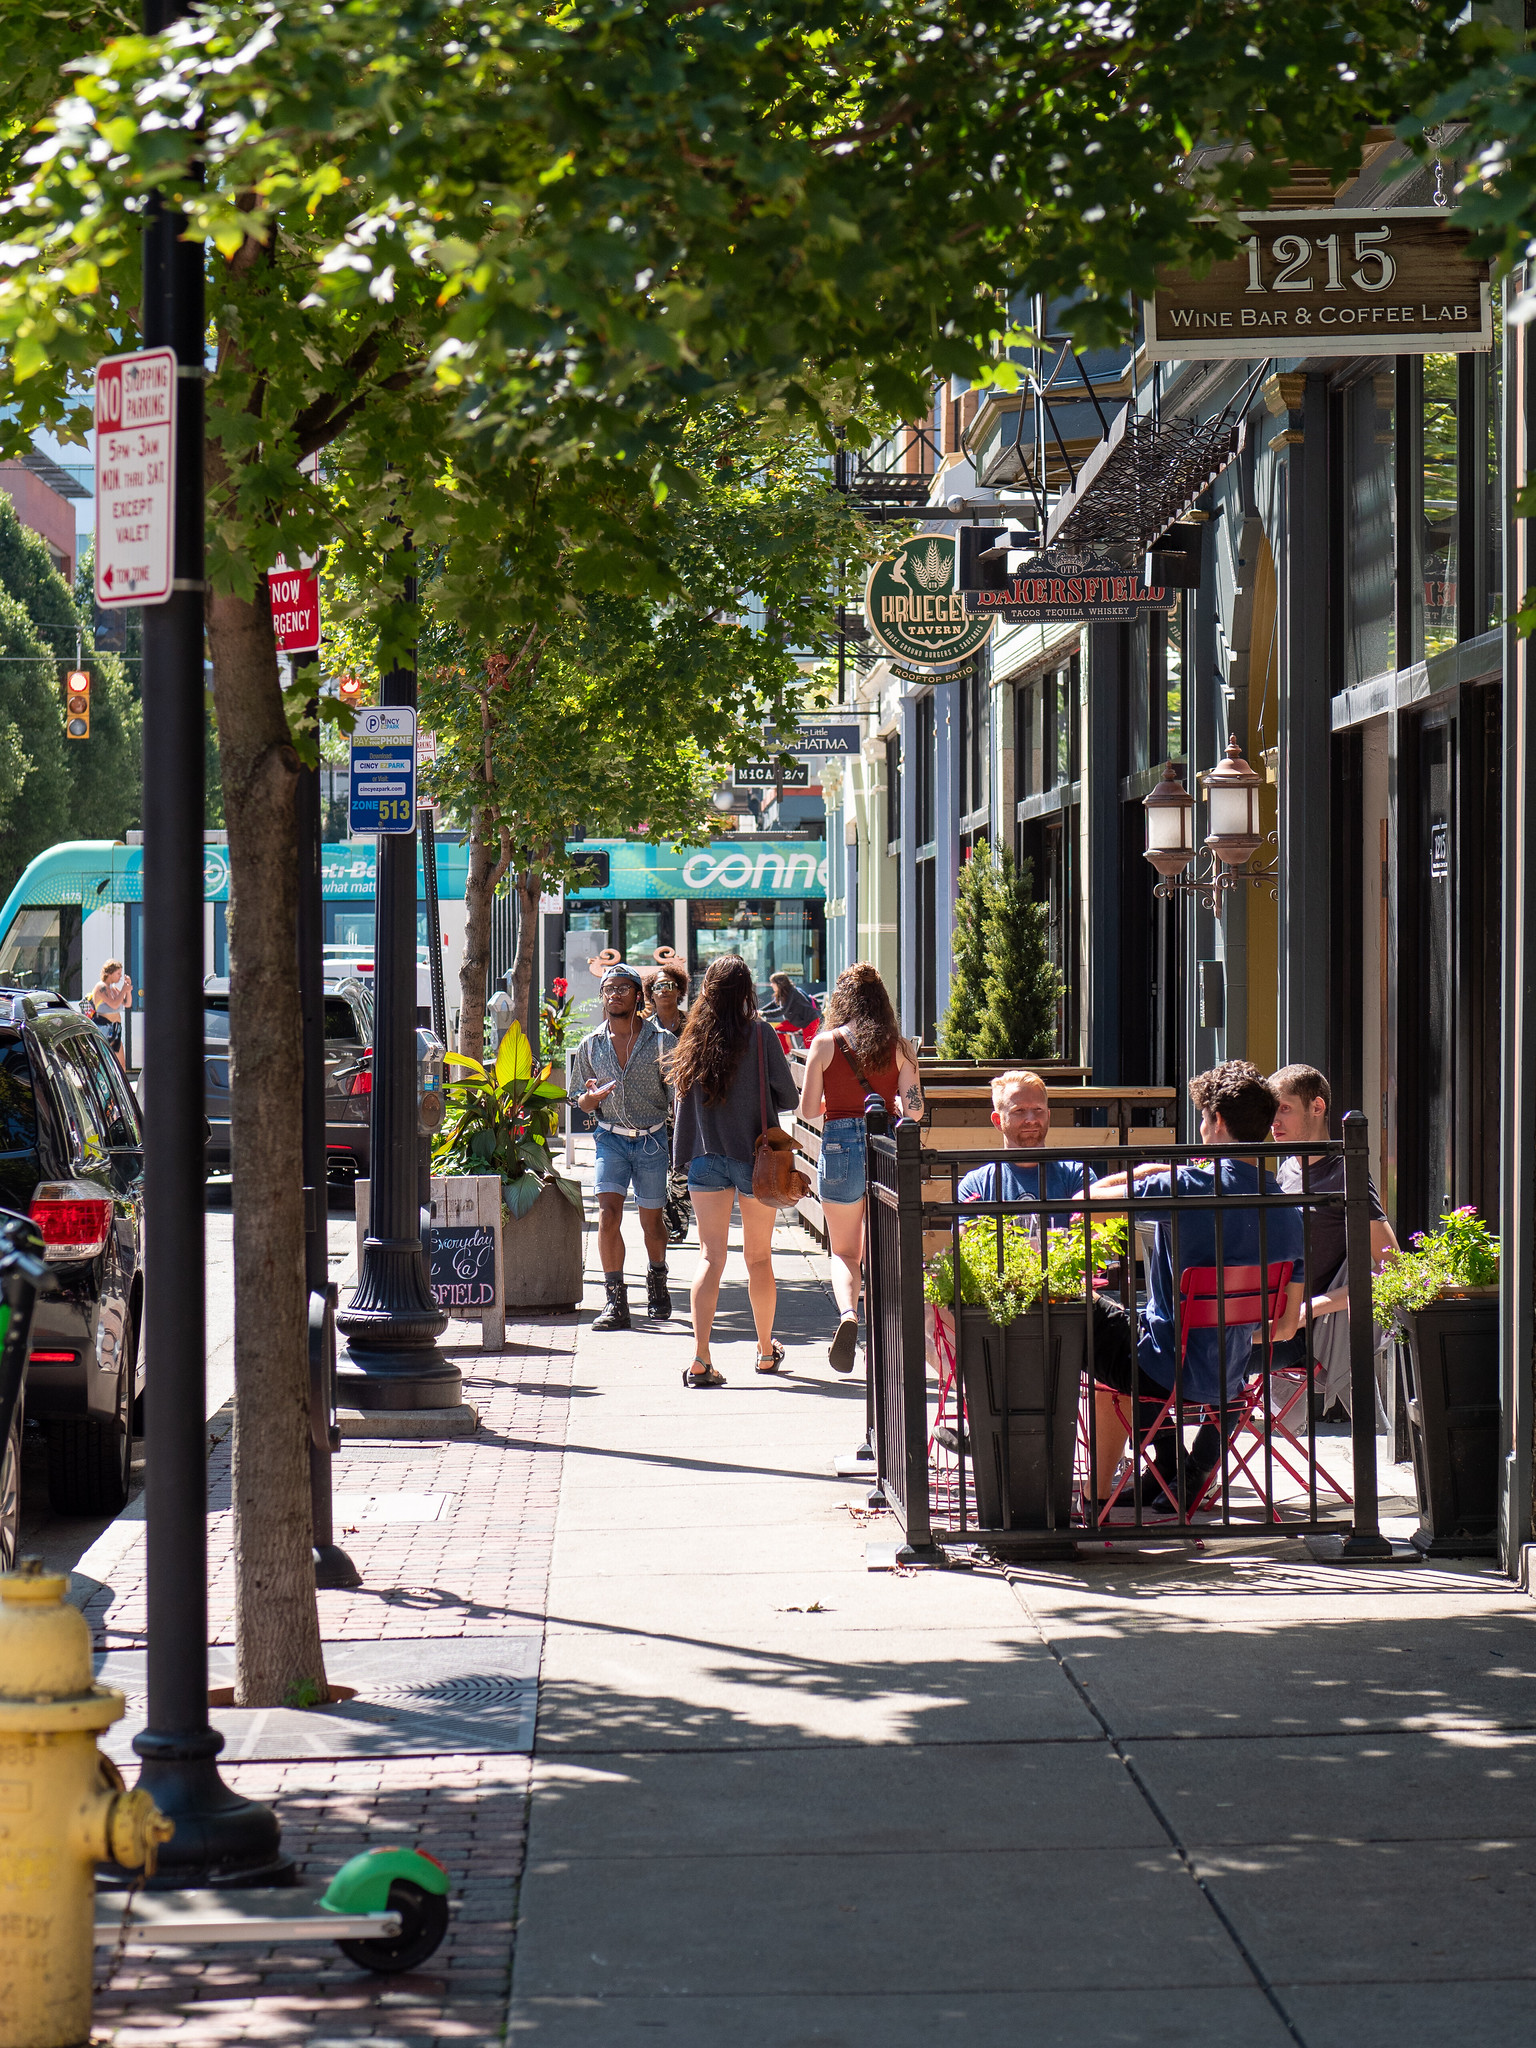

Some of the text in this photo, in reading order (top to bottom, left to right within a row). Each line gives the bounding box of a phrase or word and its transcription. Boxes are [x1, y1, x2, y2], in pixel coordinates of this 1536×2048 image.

[1243, 225, 1397, 293] 1215
[1295, 307, 1312, 324] &
[98, 376, 121, 424] NO
[127, 394, 165, 421] PARKING
[124, 472, 144, 488] THRU
[112, 498, 153, 519] EXCEPT
[116, 524, 149, 544] VALET
[116, 565, 150, 584] TOW ZONE
[1060, 565, 1078, 574] OTR
[272, 579, 300, 604] NOW
[1011, 607, 1130, 617] TACOS TEQUILA WHISKEY
[273, 609, 311, 635] RGENCY
[908, 626, 961, 635] TAVERN
[884, 627, 899, 646] HOUSE
[900, 643, 922, 657] GROUND
[925, 650, 952, 659] BURGERS
[960, 624, 984, 650] SAUSAGES
[895, 666, 973, 683] ROOFTOP PATIO
[810, 727, 828, 736] Little
[353, 736, 369, 745] PAY
[380, 736, 412, 745] PHONE
[739, 769, 805, 781] MiCA 2/v
[352, 800, 379, 810] ZONE
[379, 800, 410, 820] 513
[350, 862, 376, 878] Be
[322, 880, 376, 893] what matt
[61, 892, 82, 900] 1175
[430, 1283, 495, 1305] SFIELD
